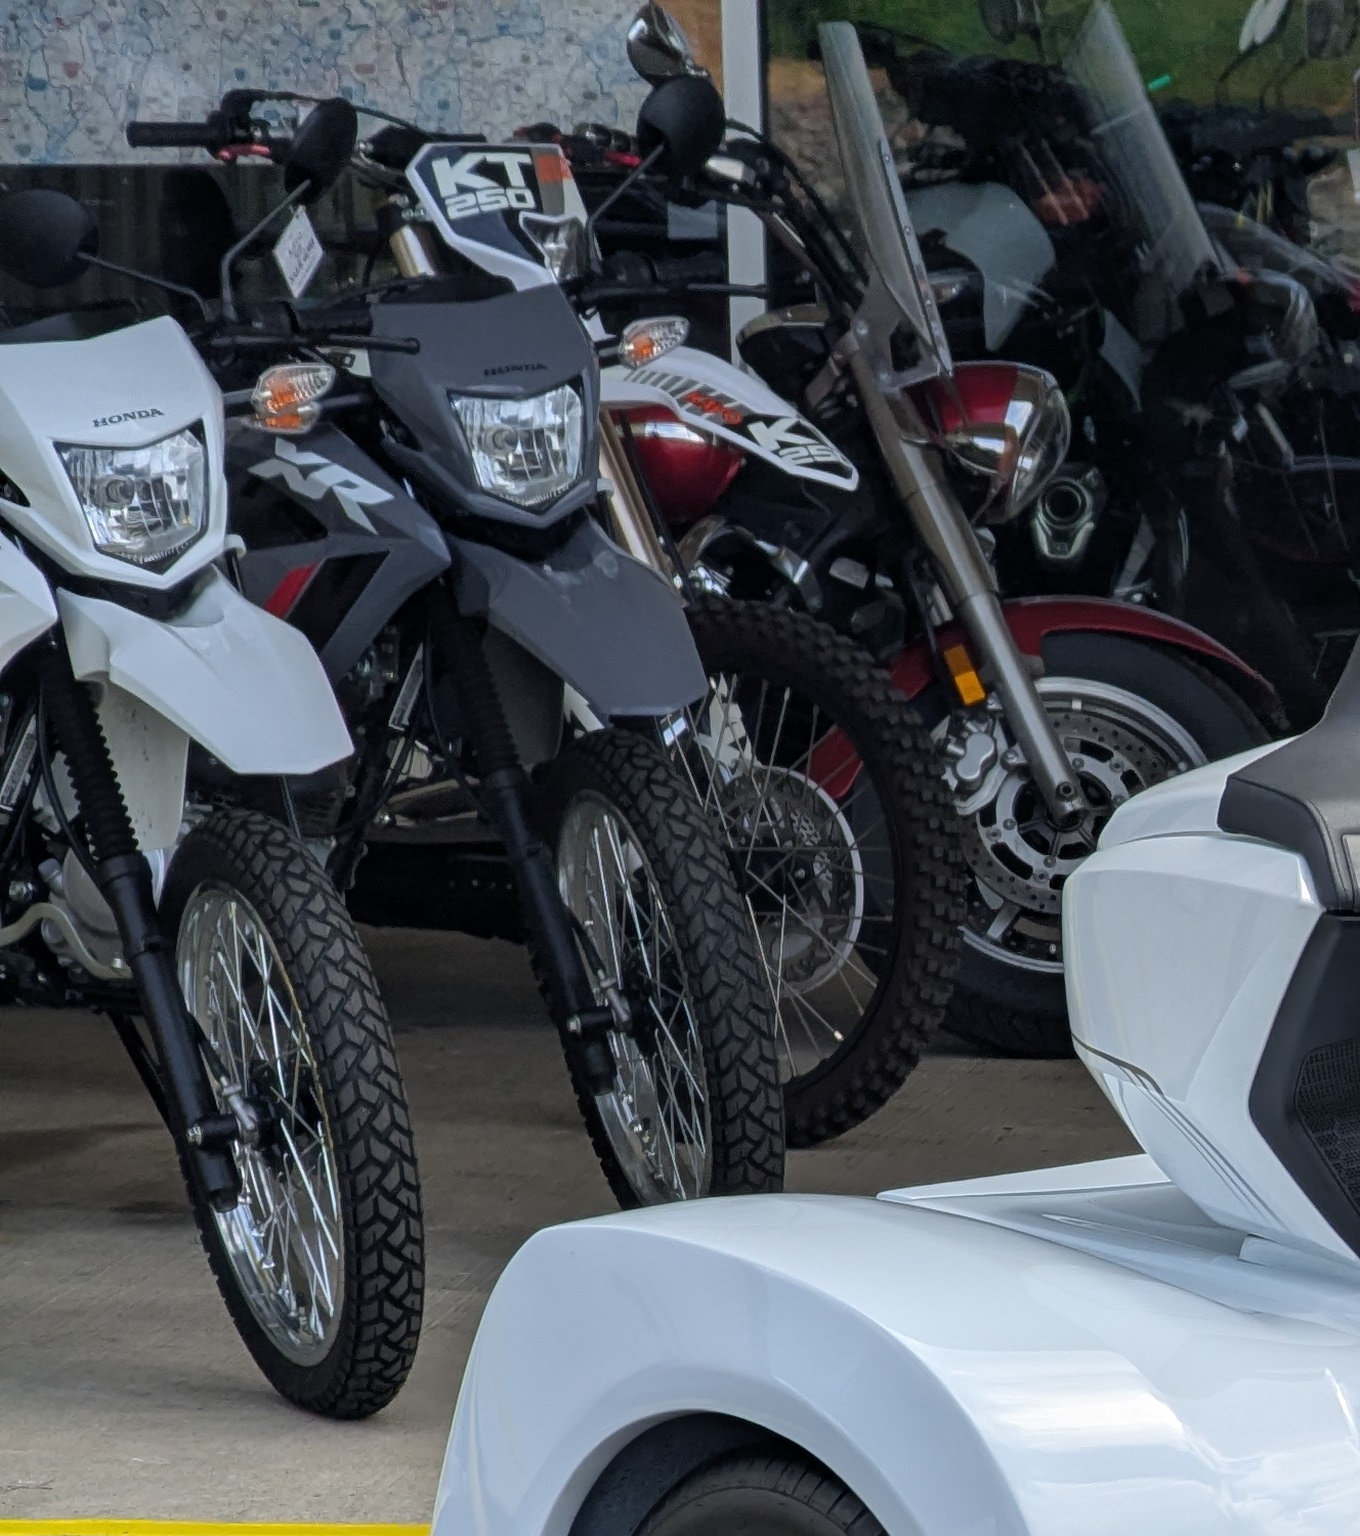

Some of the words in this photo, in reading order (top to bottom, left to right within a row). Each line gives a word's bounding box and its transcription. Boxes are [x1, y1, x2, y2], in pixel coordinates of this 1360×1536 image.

[431, 152, 532, 198] KT
[444, 187, 537, 220] 250
[92, 407, 165, 428] HONDA
